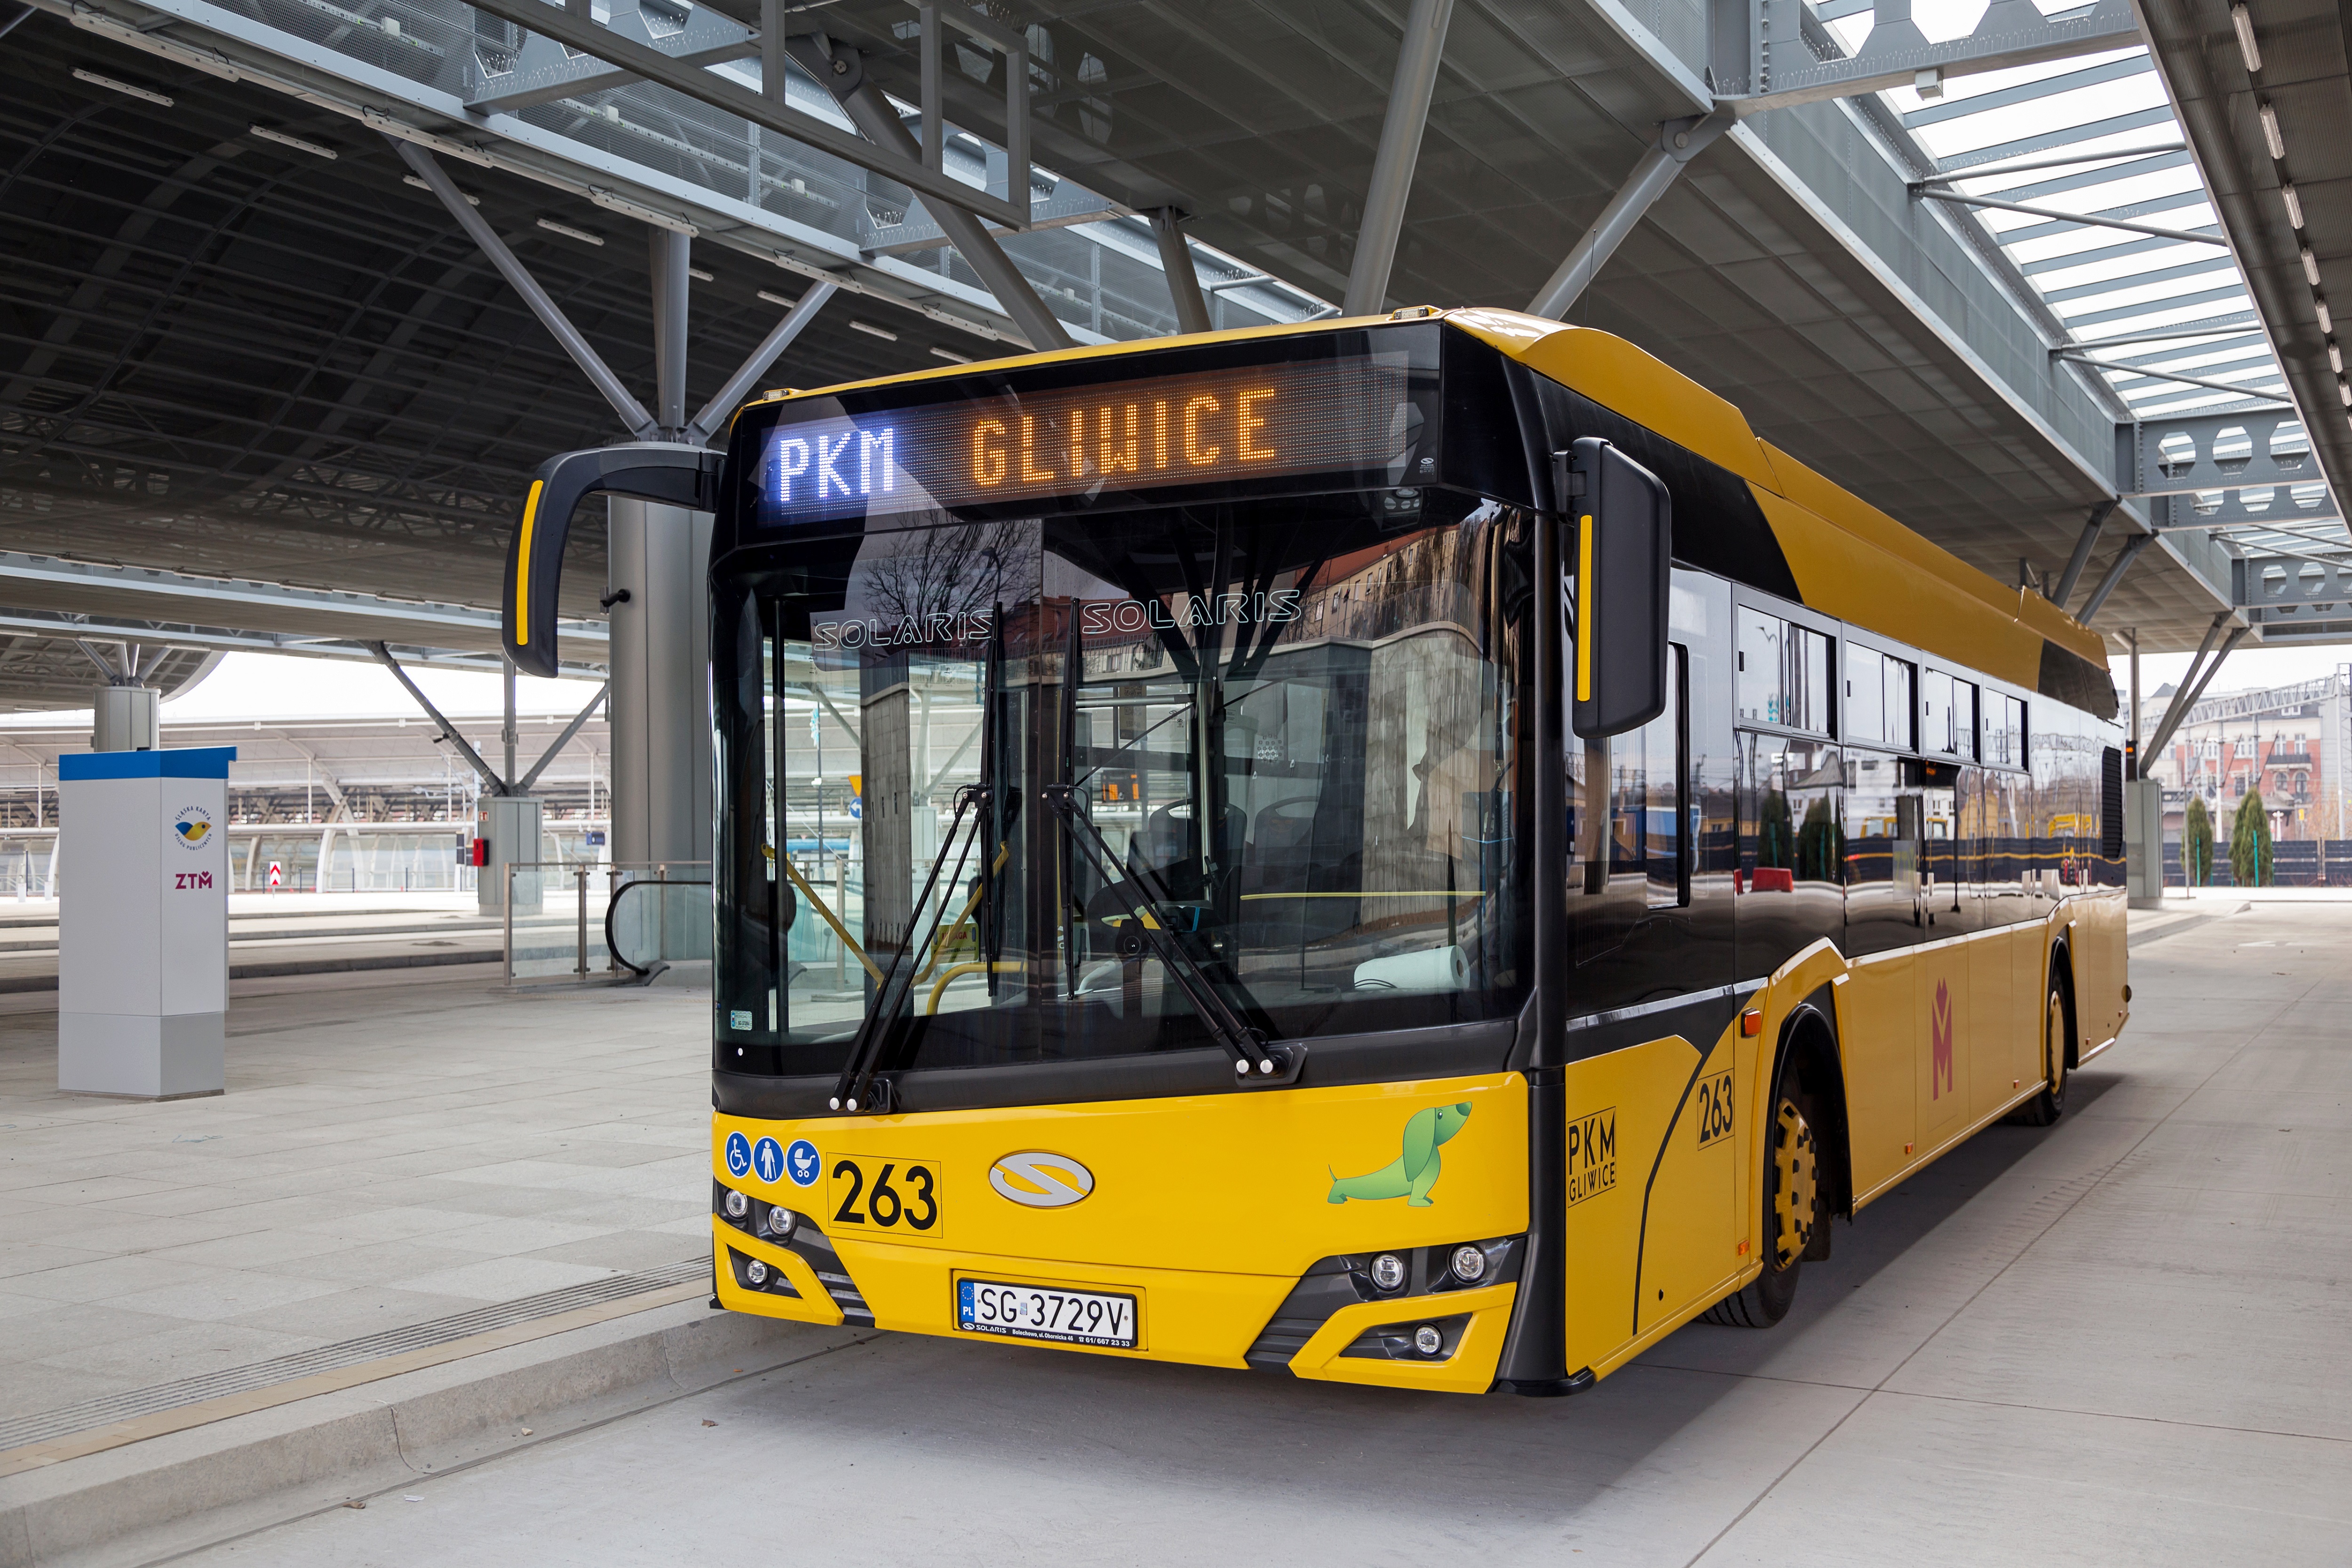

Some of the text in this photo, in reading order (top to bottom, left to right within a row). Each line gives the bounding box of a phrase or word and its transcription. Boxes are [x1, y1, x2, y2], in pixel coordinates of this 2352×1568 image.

[780, 388, 1275, 502] PKM GLIWICE
[814, 609, 993, 651] SOLARIS
[1082, 589, 1301, 634] SOLARIS
[196, 806, 211, 820] KARTA
[186, 833, 212, 851] PUBLICZNYCH
[175, 871, 212, 889] ZTM
[1699, 1075, 1733, 1144] 263
[1569, 1110, 1615, 1176] PKM
[832, 1160, 937, 1231] 263
[1569, 1162, 1615, 1202] GLIWICE
[963, 1305, 973, 1316] PL
[976, 1324, 1007, 1333] SOLARIS
[981, 1288, 1123, 1336] SG 3729V
[1012, 1329, 1039, 1338] Bolechowo,
